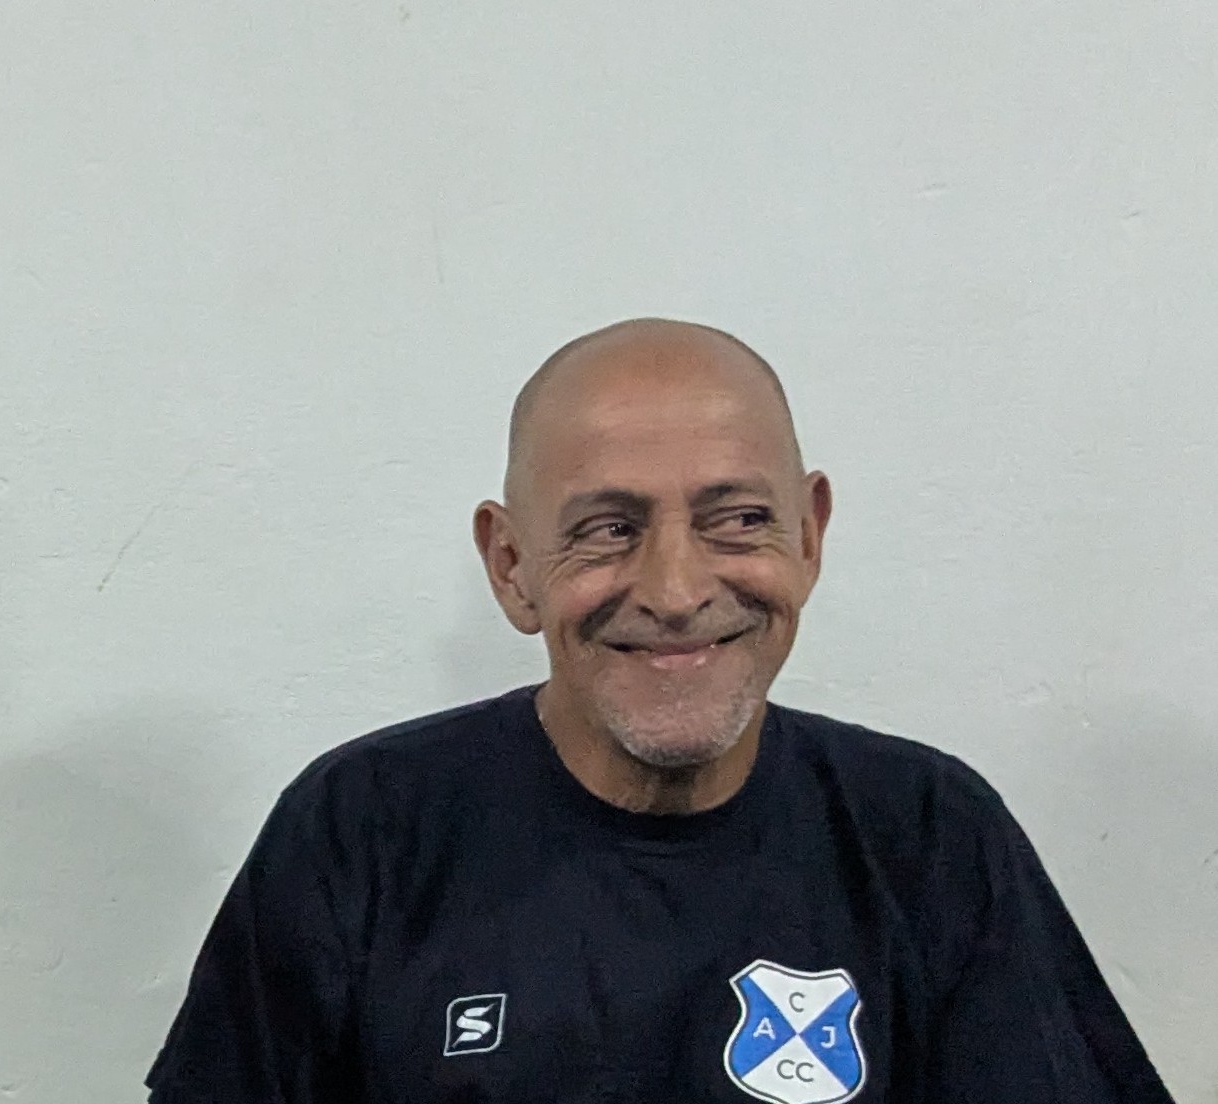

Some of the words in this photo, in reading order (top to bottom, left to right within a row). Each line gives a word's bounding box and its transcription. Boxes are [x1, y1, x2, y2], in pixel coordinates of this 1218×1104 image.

[788, 991, 806, 1013] C
[752, 1016, 776, 1041] A
[820, 1025, 837, 1049] J
[776, 1058, 815, 1083] CC
